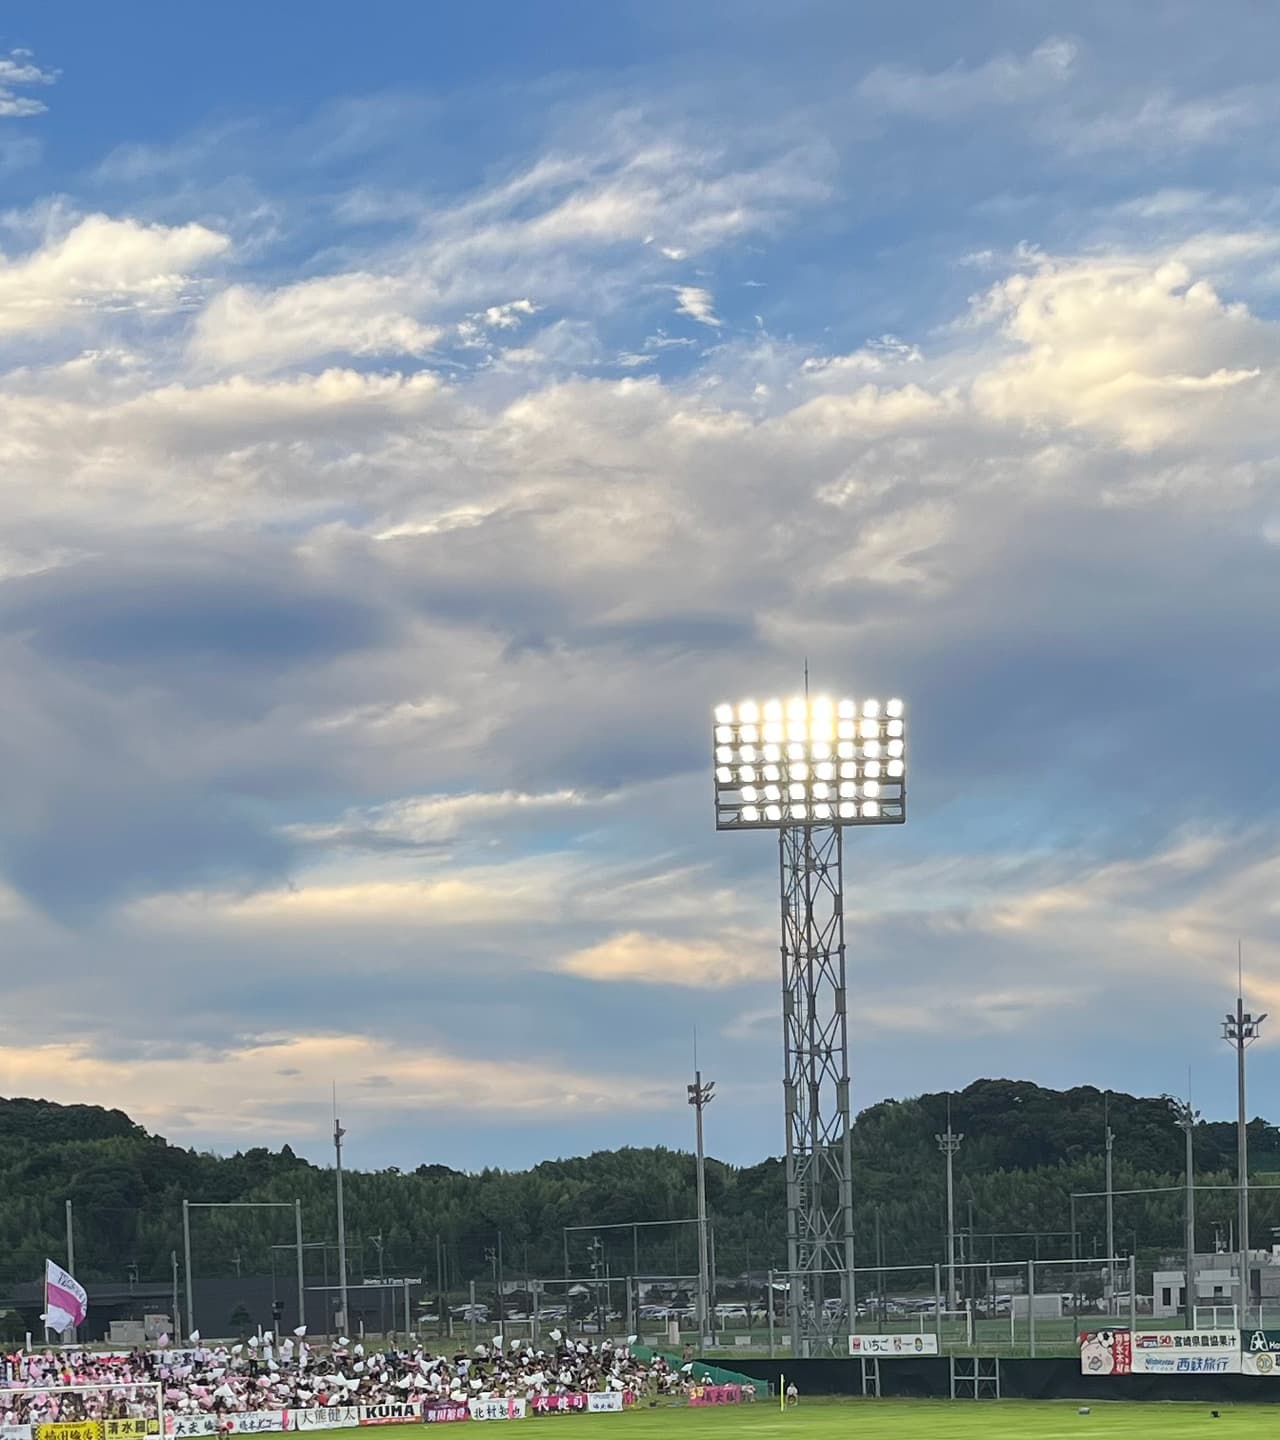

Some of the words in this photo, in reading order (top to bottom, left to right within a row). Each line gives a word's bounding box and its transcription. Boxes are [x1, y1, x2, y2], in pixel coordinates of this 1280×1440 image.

[863, 1338, 889, 1352] いちご
[1176, 1357, 1231, 1373] 西鉄旅行
[366, 1404, 415, 1418] KUMA
